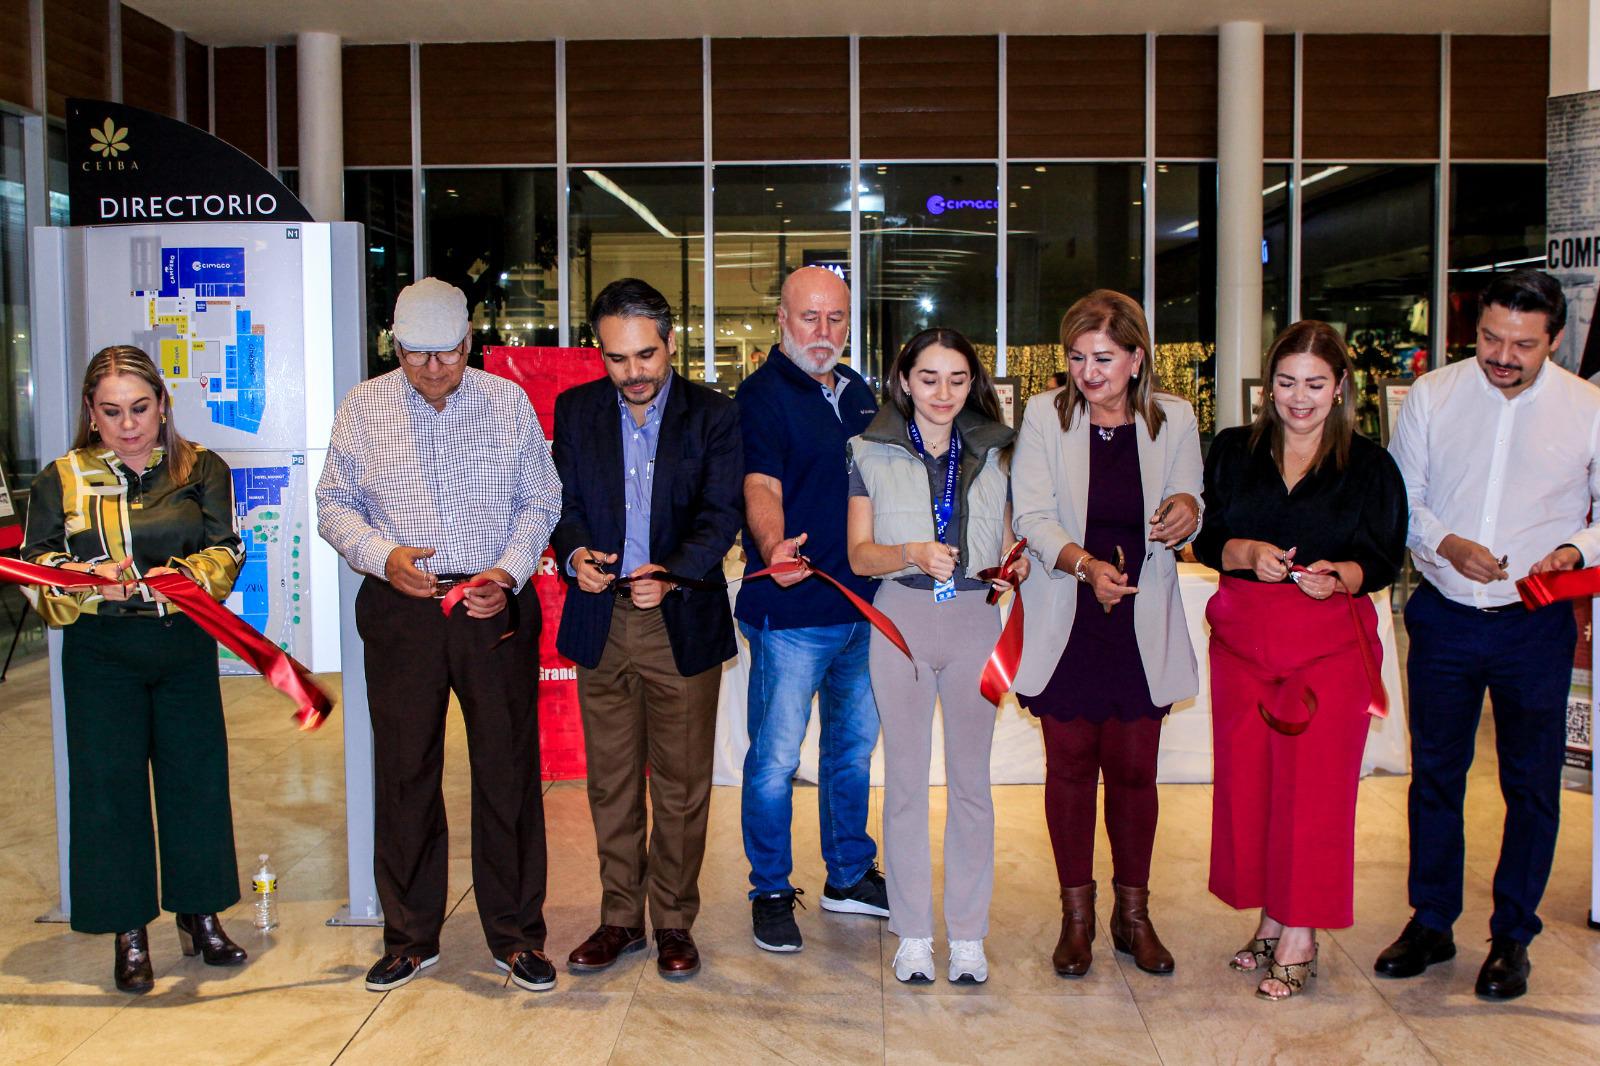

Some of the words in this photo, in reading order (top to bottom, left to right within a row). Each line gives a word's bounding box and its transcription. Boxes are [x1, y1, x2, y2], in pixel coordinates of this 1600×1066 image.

[82, 161, 139, 171] CEIBA
[100, 194, 277, 219] DIRECTORIO
[287, 229, 299, 239] N1
[944, 460, 955, 508] COMERCIALES
